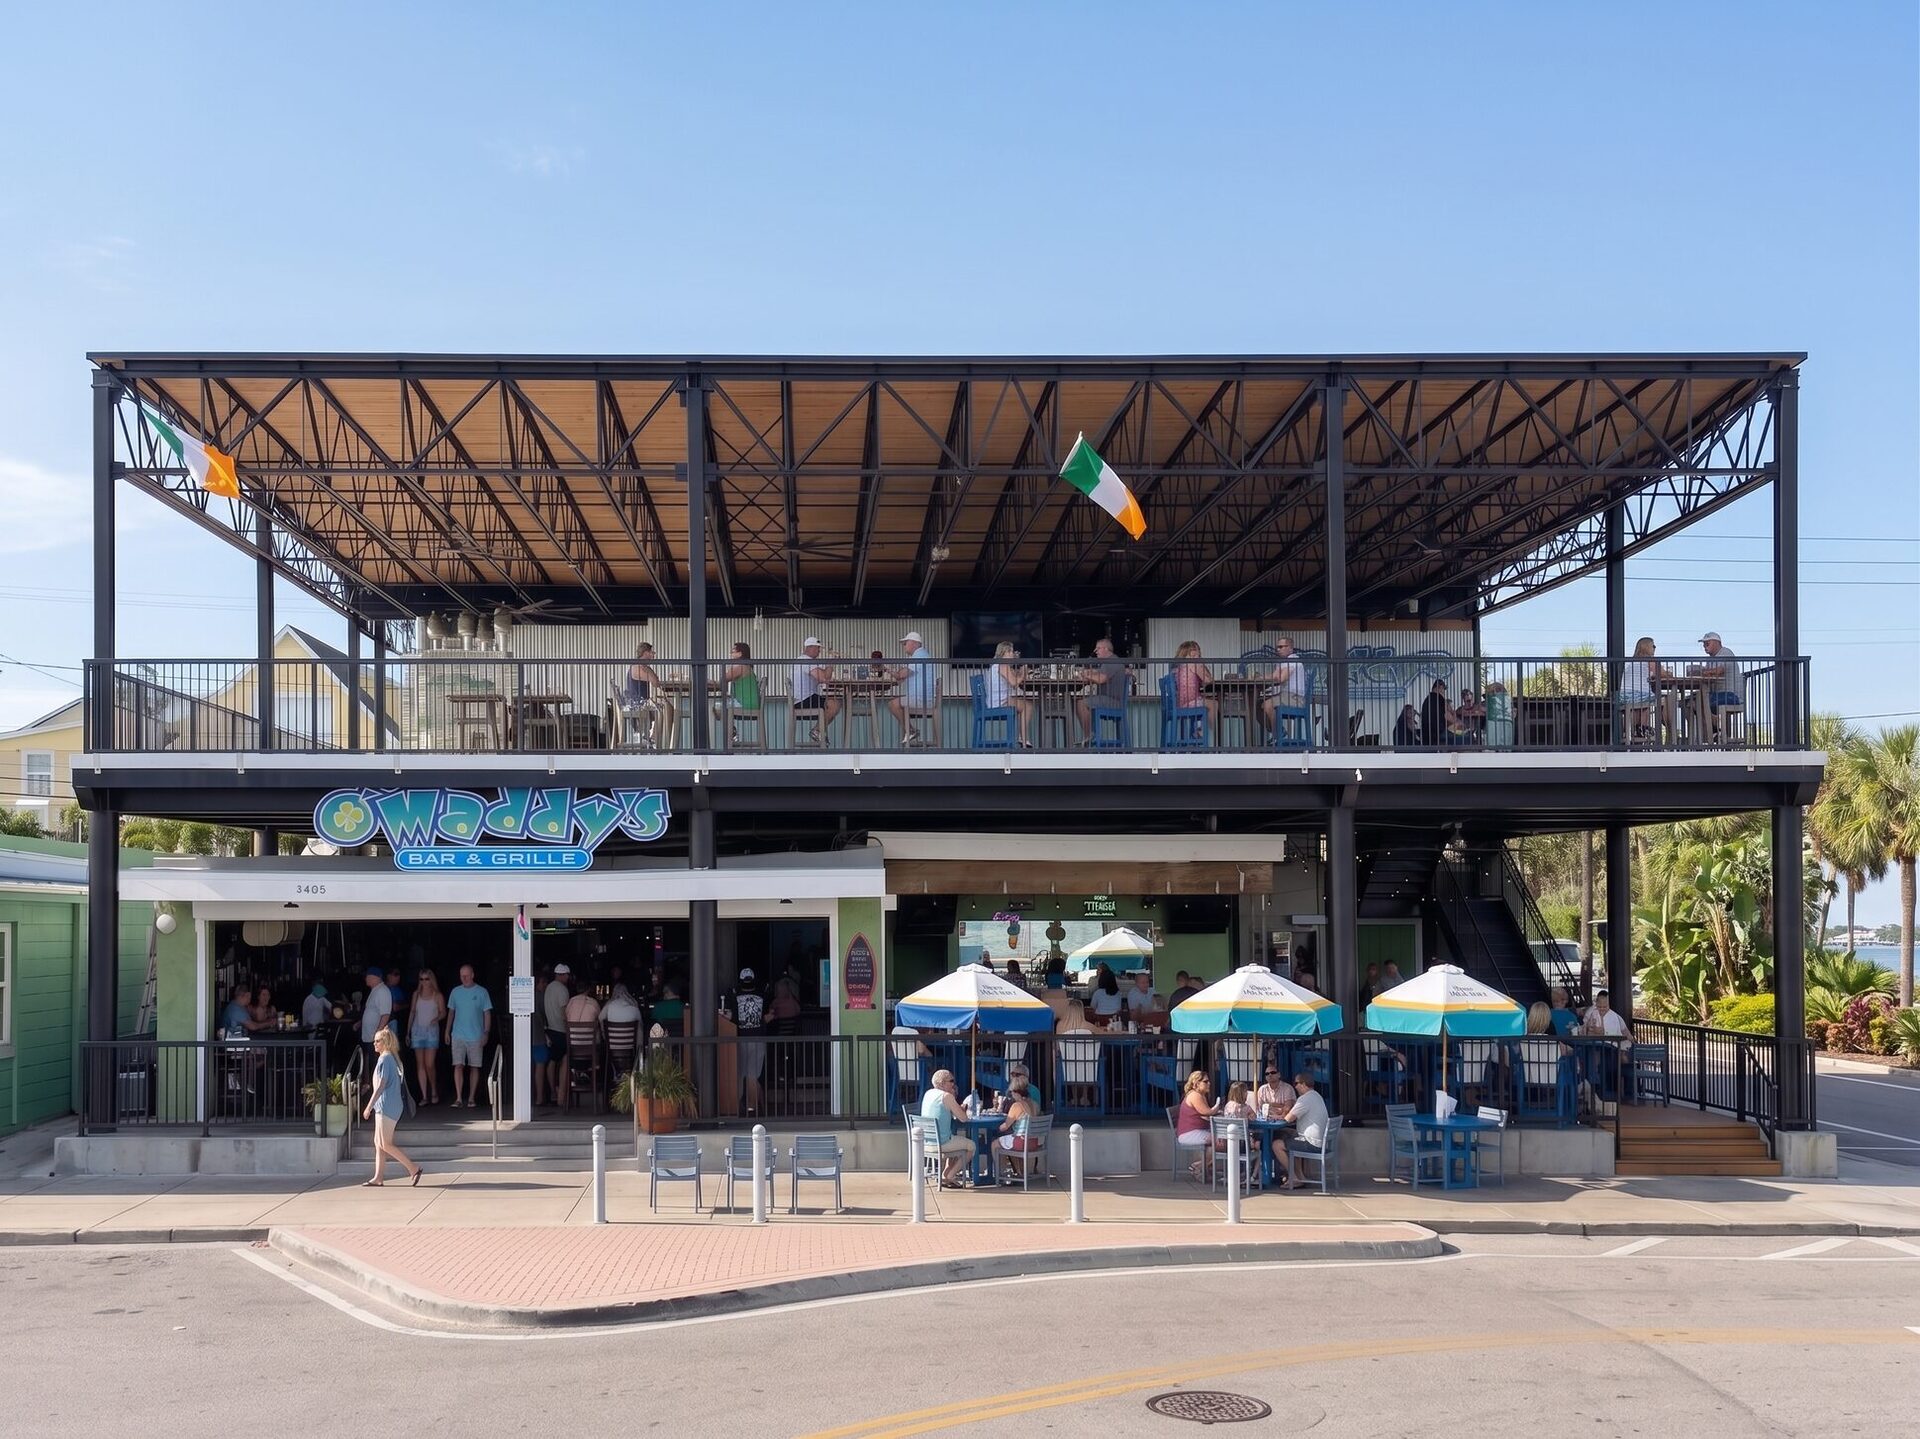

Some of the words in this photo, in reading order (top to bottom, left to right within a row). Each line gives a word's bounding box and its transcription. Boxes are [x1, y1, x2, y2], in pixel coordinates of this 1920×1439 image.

[408, 853, 455, 865] BAR
[466, 853, 482, 865] &
[491, 853, 576, 865] GRILLE
[296, 884, 326, 894] 3405
